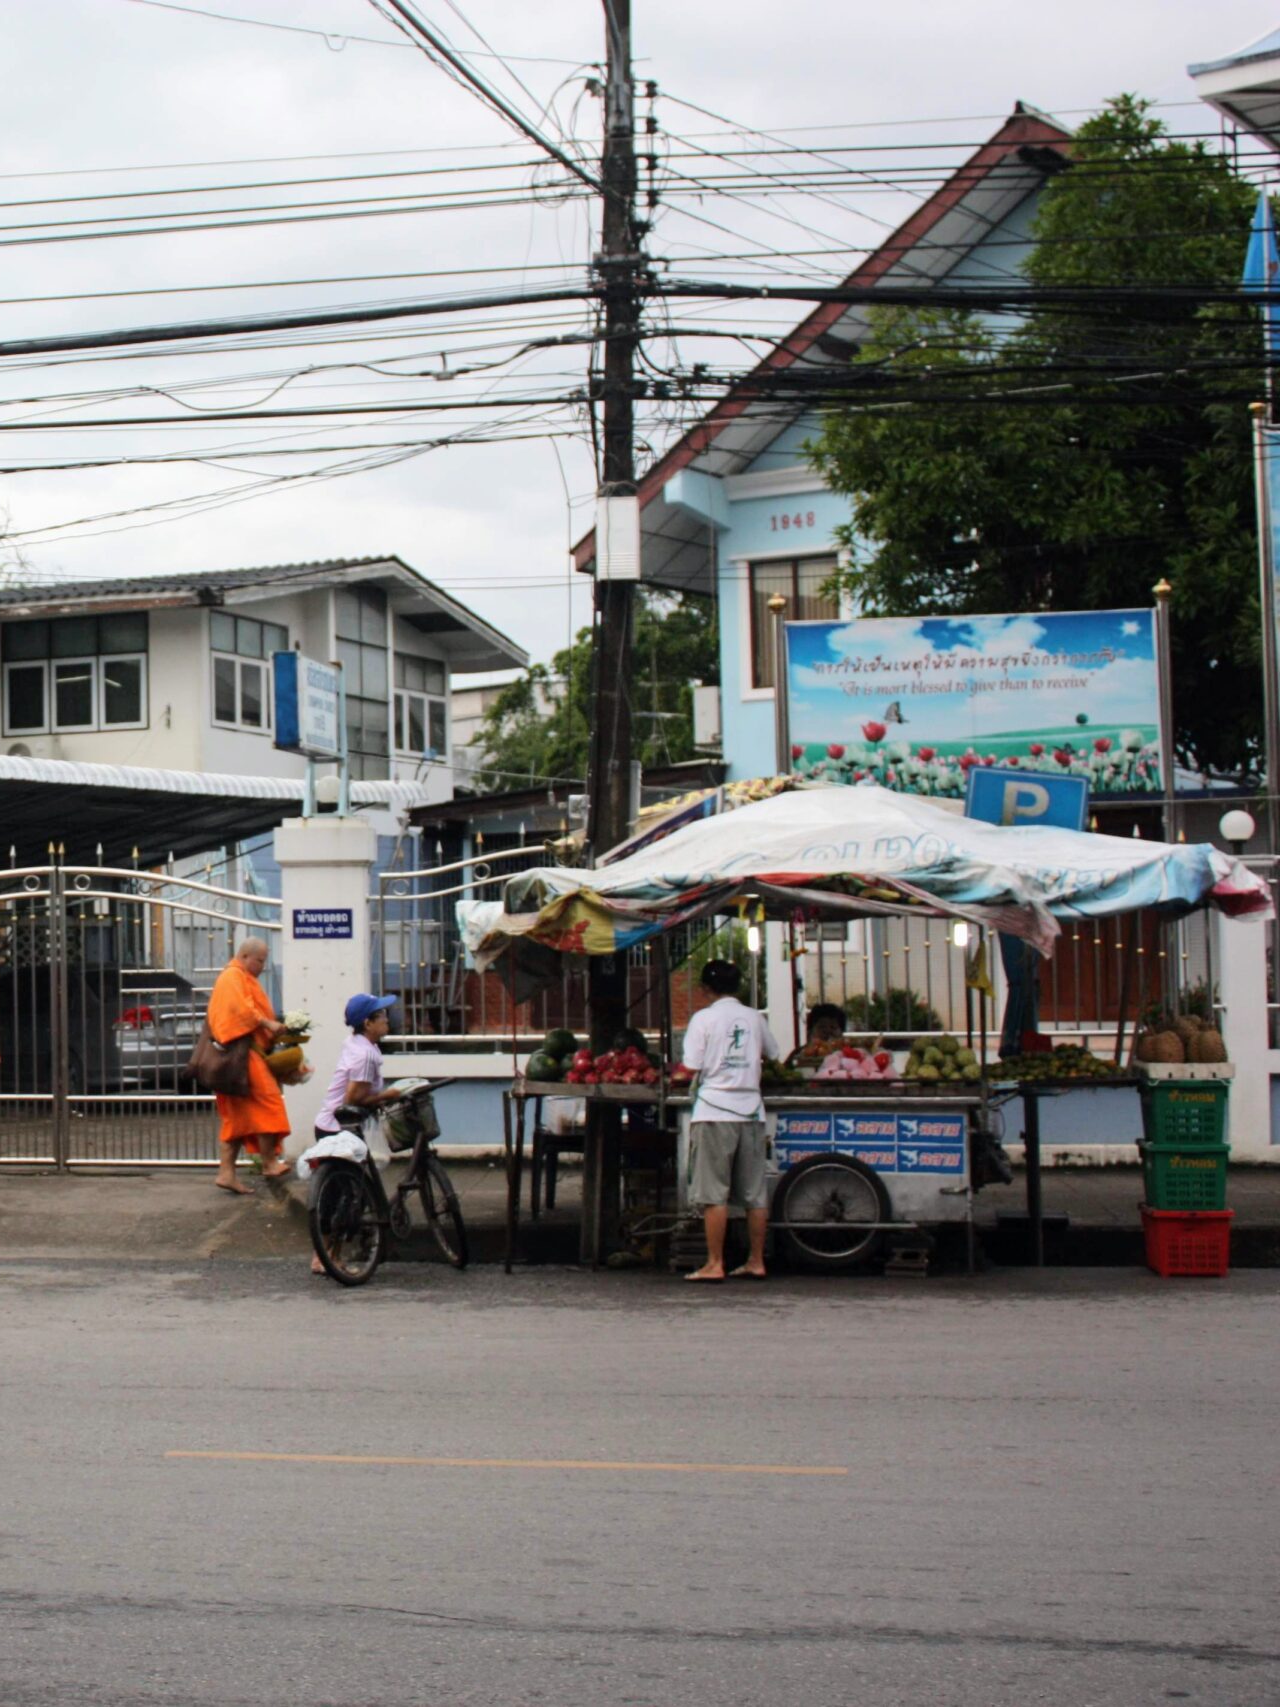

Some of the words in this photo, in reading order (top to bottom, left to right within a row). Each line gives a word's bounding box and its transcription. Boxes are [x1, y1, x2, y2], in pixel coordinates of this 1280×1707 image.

[769, 511, 815, 532] 1948
[863, 682, 873, 696] is
[911, 679, 953, 694] blessed
[955, 681, 967, 693] to
[969, 678, 996, 697] give
[999, 677, 1028, 691] than
[1031, 678, 1043, 690] to
[1002, 781, 1050, 826] P
